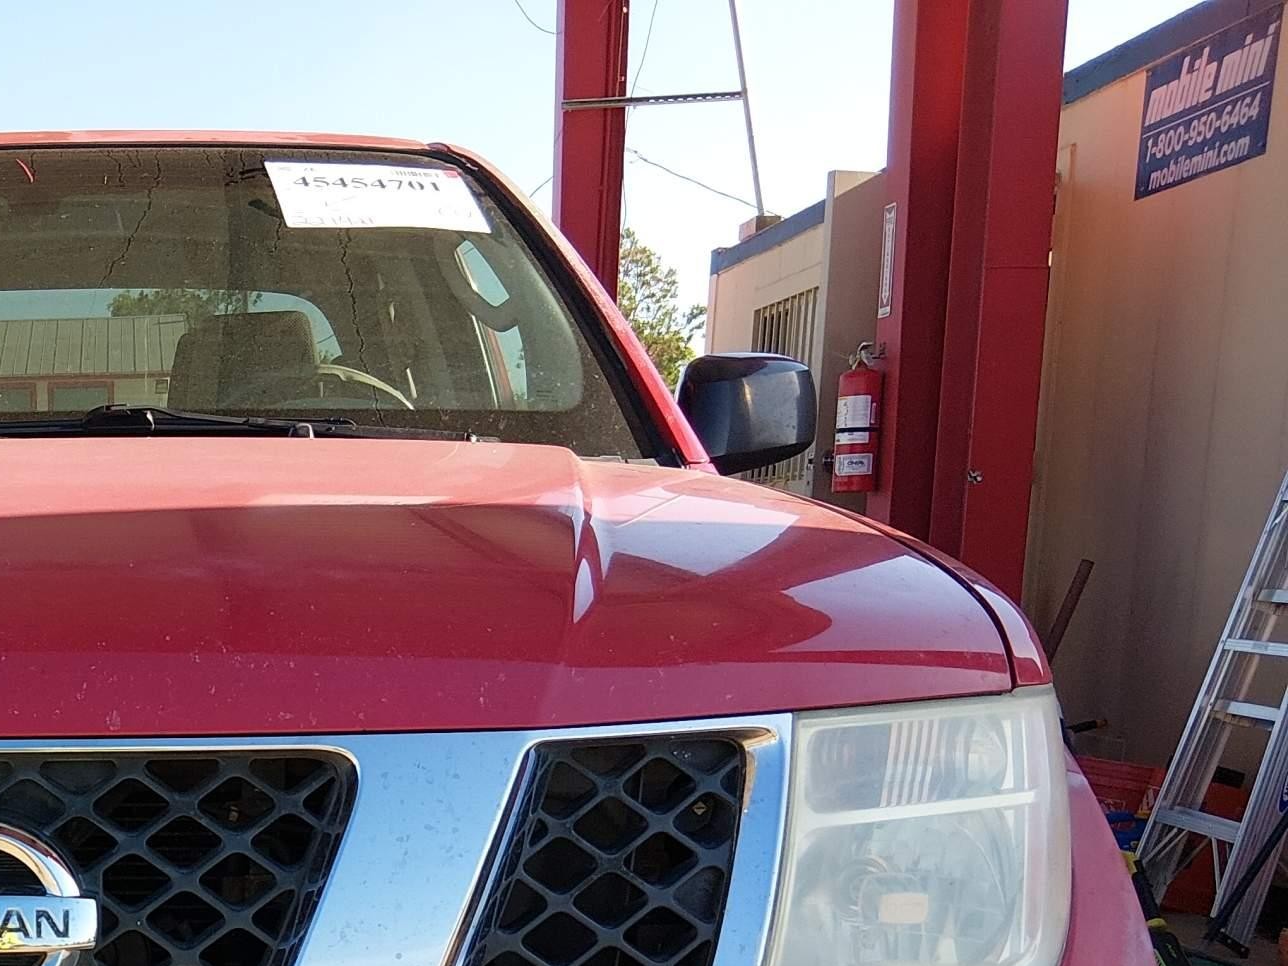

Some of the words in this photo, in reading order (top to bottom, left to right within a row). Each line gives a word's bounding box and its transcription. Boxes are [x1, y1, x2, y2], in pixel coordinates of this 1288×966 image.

[1144, 46, 1218, 127] mobile
[1215, 20, 1281, 96] mini
[1145, 92, 1262, 164] 1-800-950-6464
[292, 175, 441, 192] 45454701
[1148, 135, 1251, 191] mobilemini.com
